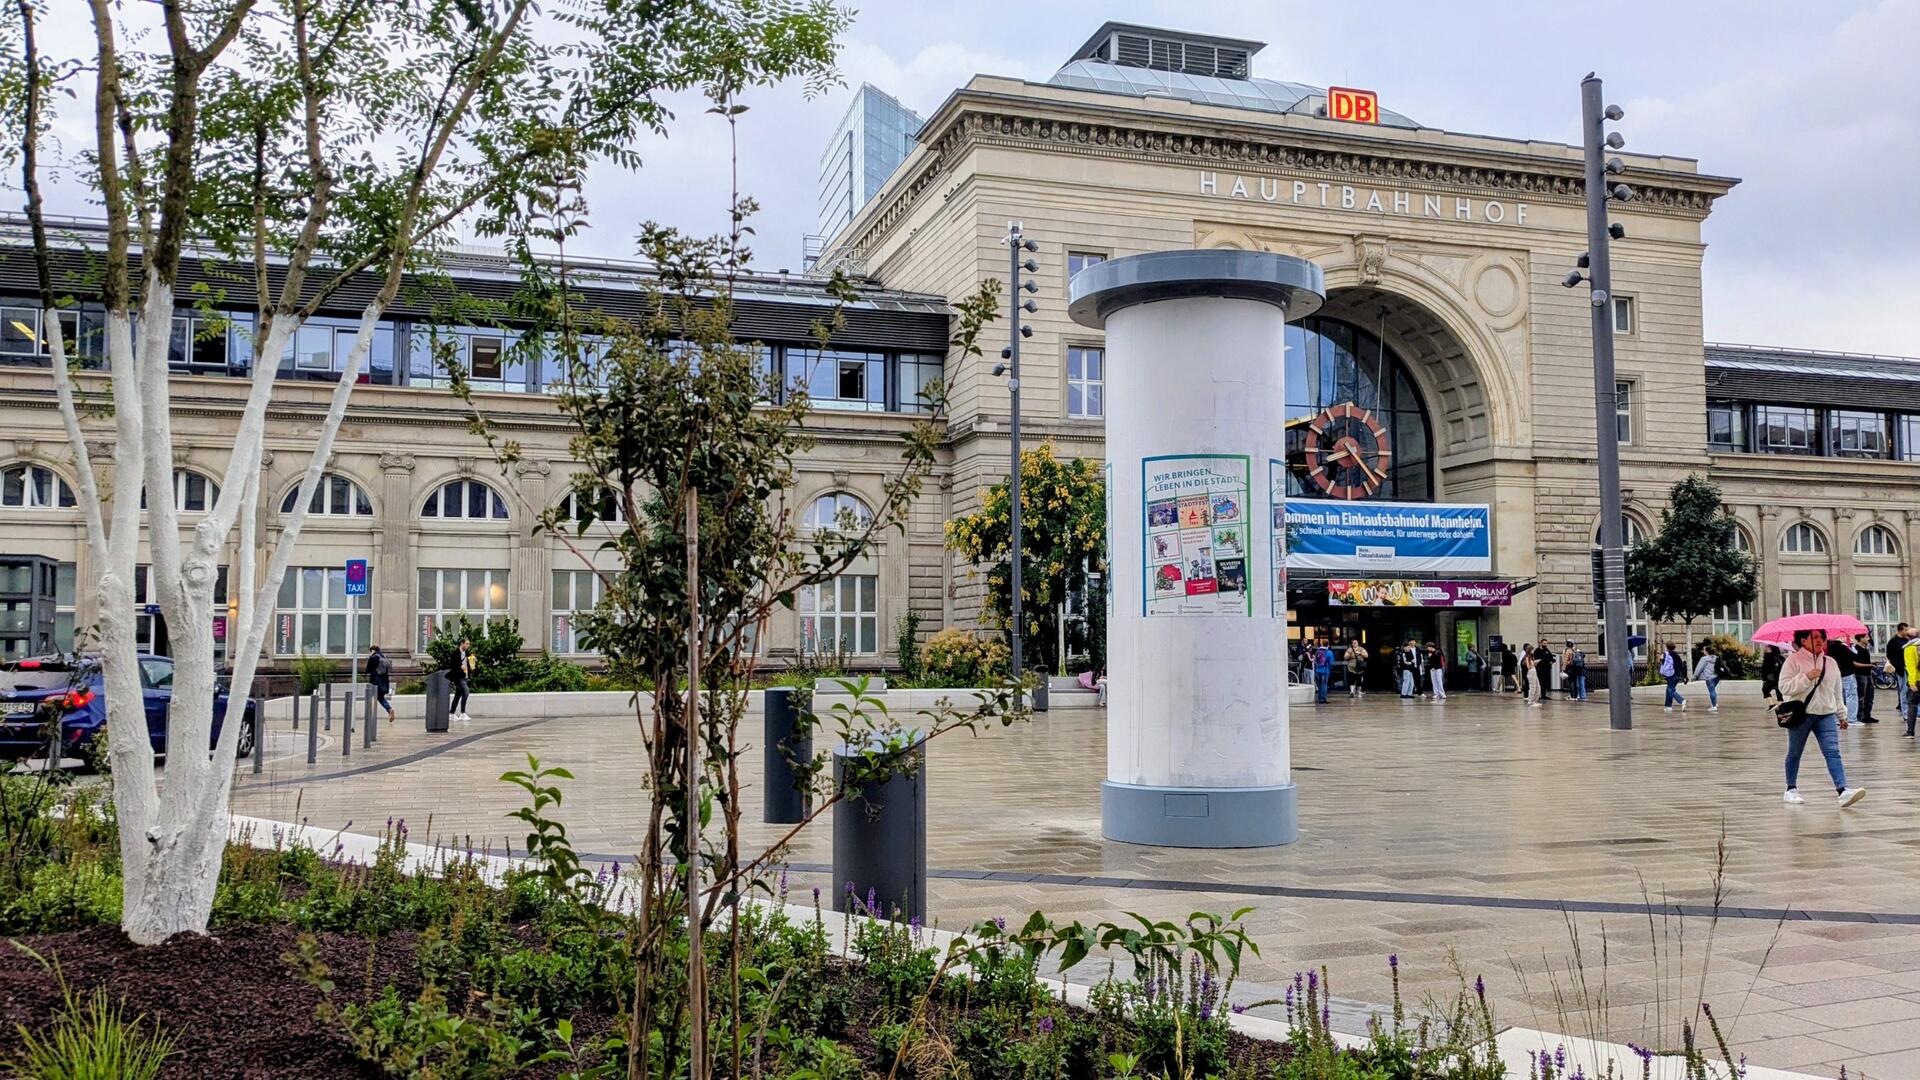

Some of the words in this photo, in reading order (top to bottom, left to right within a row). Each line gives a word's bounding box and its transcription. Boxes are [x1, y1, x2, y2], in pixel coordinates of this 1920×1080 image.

[1335, 93, 1372, 122] DB
[1200, 170, 1528, 225] HAUPTBAHNHOF
[1154, 473, 1170, 482] WIR
[1171, 468, 1212, 480] BRINGEN
[1154, 482, 1181, 492] LEBEN
[1182, 480, 1193, 488] IN
[1194, 478, 1209, 487] DIE
[1210, 475, 1240, 485] STADT!
[1326, 511, 1340, 525] im
[1342, 512, 1429, 528] Einkaufsbahnhof
[1431, 515, 1485, 528] Mannheim.
[1299, 526, 1322, 535] schnell
[1323, 527, 1337, 535] und
[1337, 528, 1363, 538] bequem
[1363, 529, 1396, 538] einkaufen,
[1396, 529, 1405, 538] für
[1407, 530, 1438, 539] unterwegs
[1439, 530, 1452, 538] oder
[347, 583, 365, 592] TAXI
